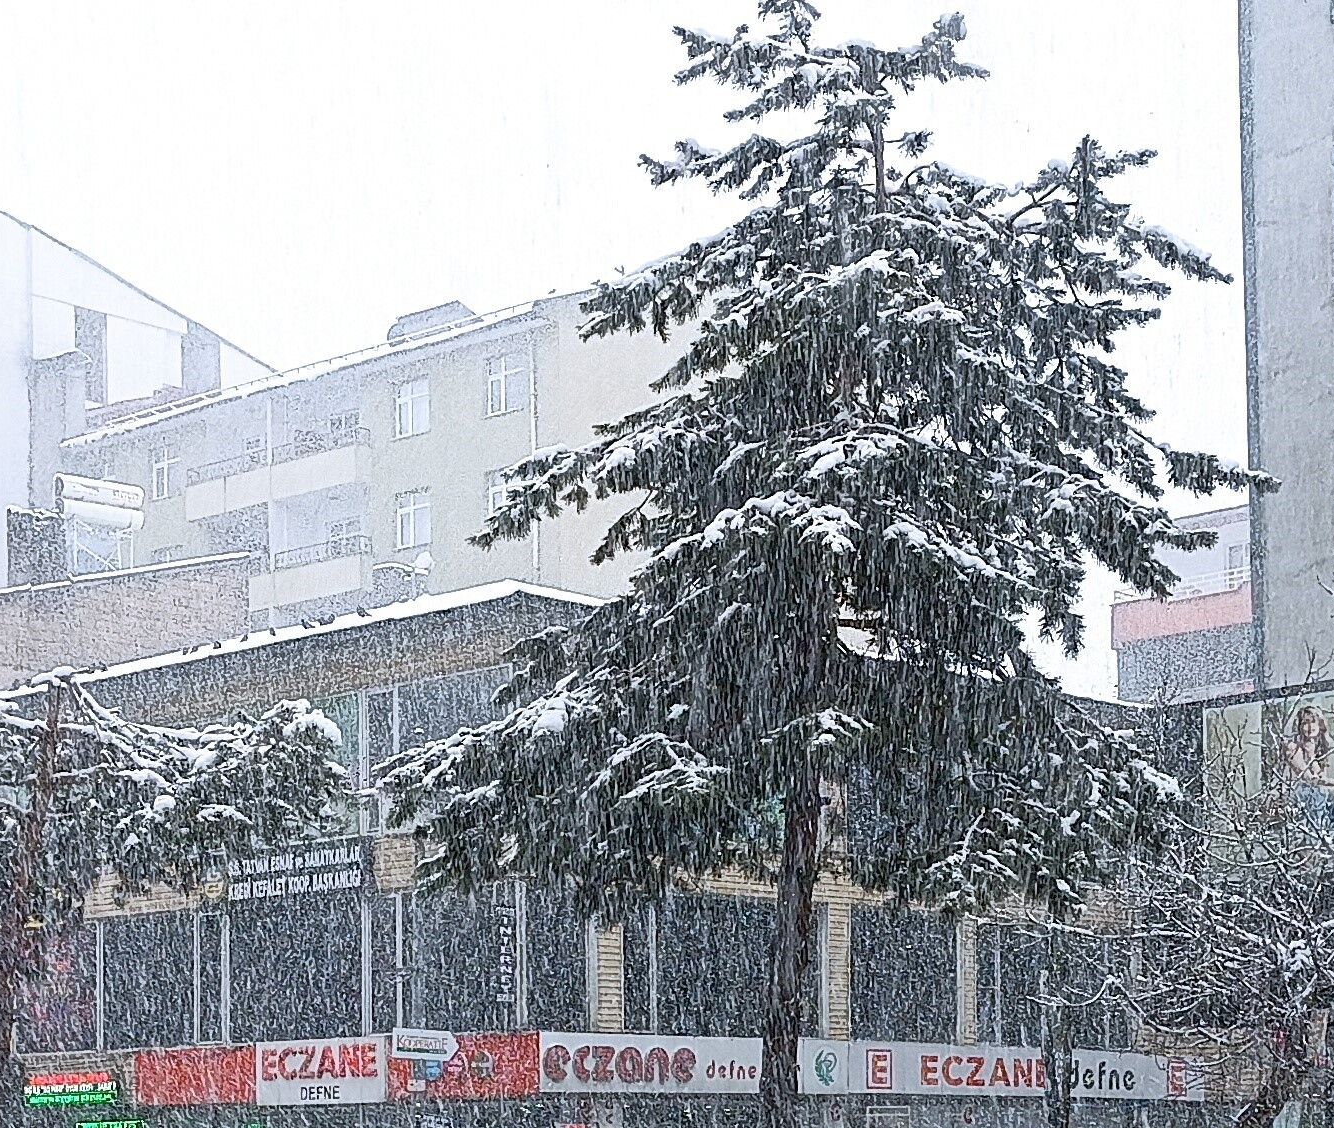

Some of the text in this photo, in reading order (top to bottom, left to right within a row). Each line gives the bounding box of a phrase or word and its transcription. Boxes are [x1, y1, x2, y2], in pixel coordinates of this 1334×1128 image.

[261, 1042, 378, 1082] ECZANE
[542, 1044, 758, 1085] eczane defne
[300, 1085, 341, 1101] DEFNE
